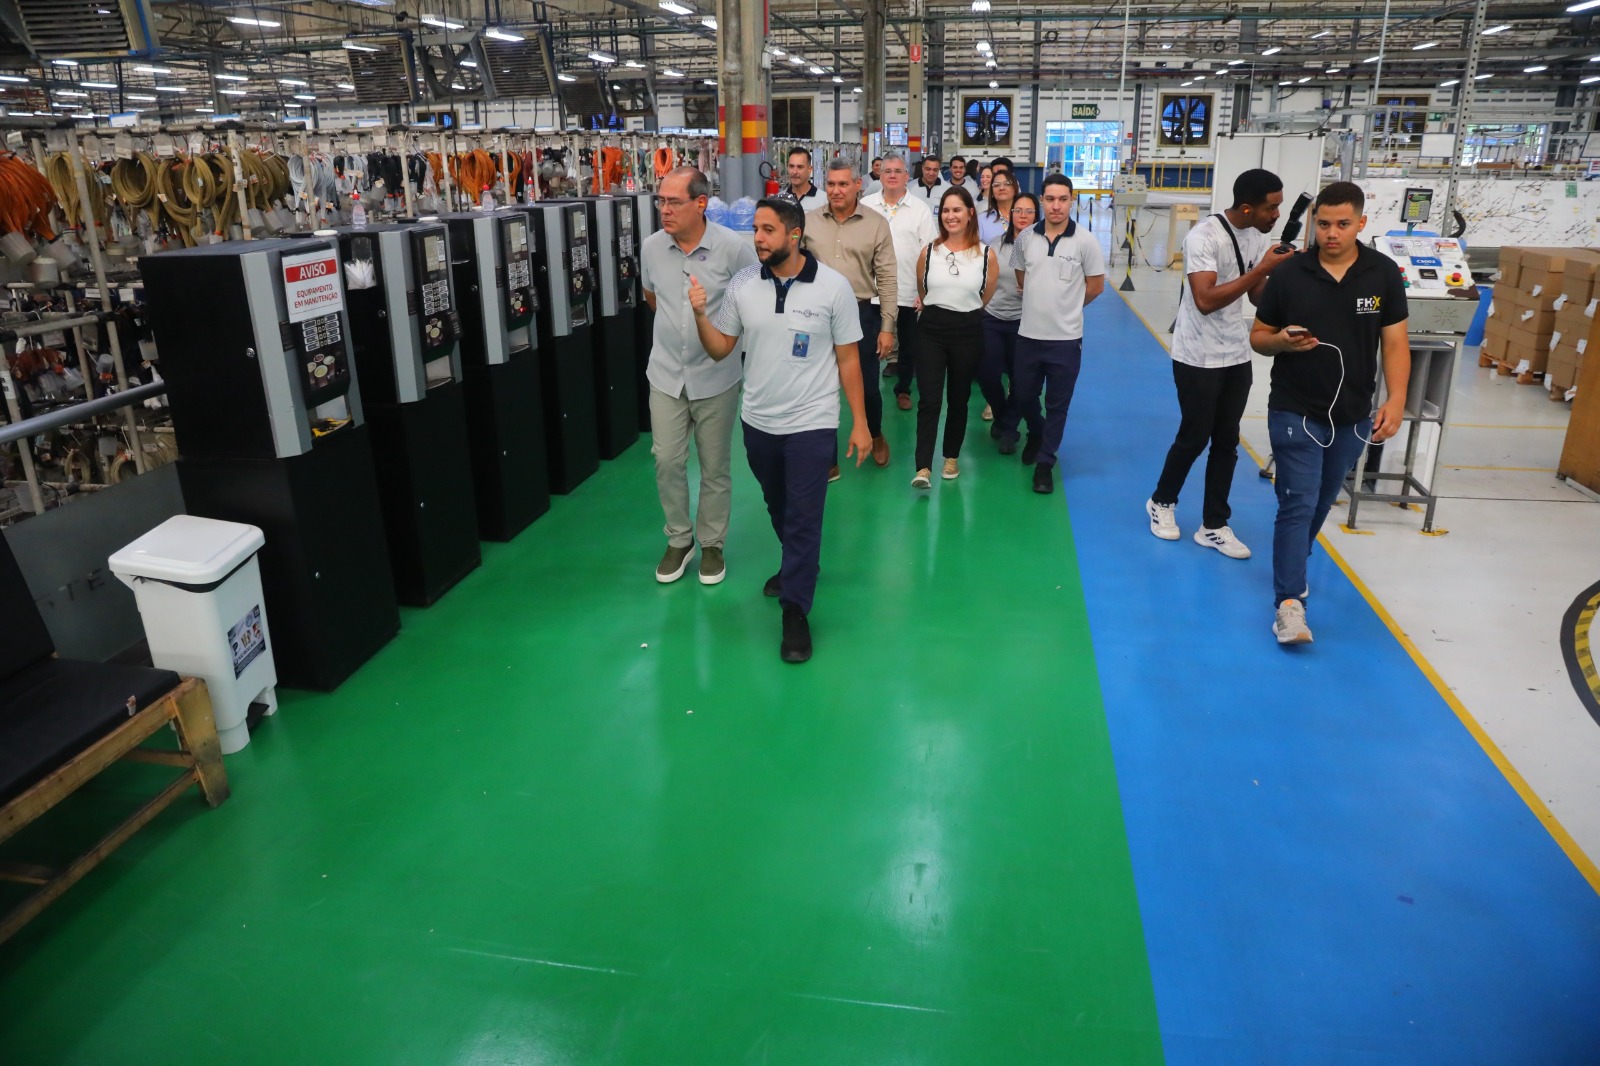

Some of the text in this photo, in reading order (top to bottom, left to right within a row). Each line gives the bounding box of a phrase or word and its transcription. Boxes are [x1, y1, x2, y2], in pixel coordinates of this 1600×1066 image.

[300, 263, 326, 279] AVISO
[297, 284, 333, 297] EQUIPAMENTO
[294, 292, 338, 309] EM MANUTENÇÃO
